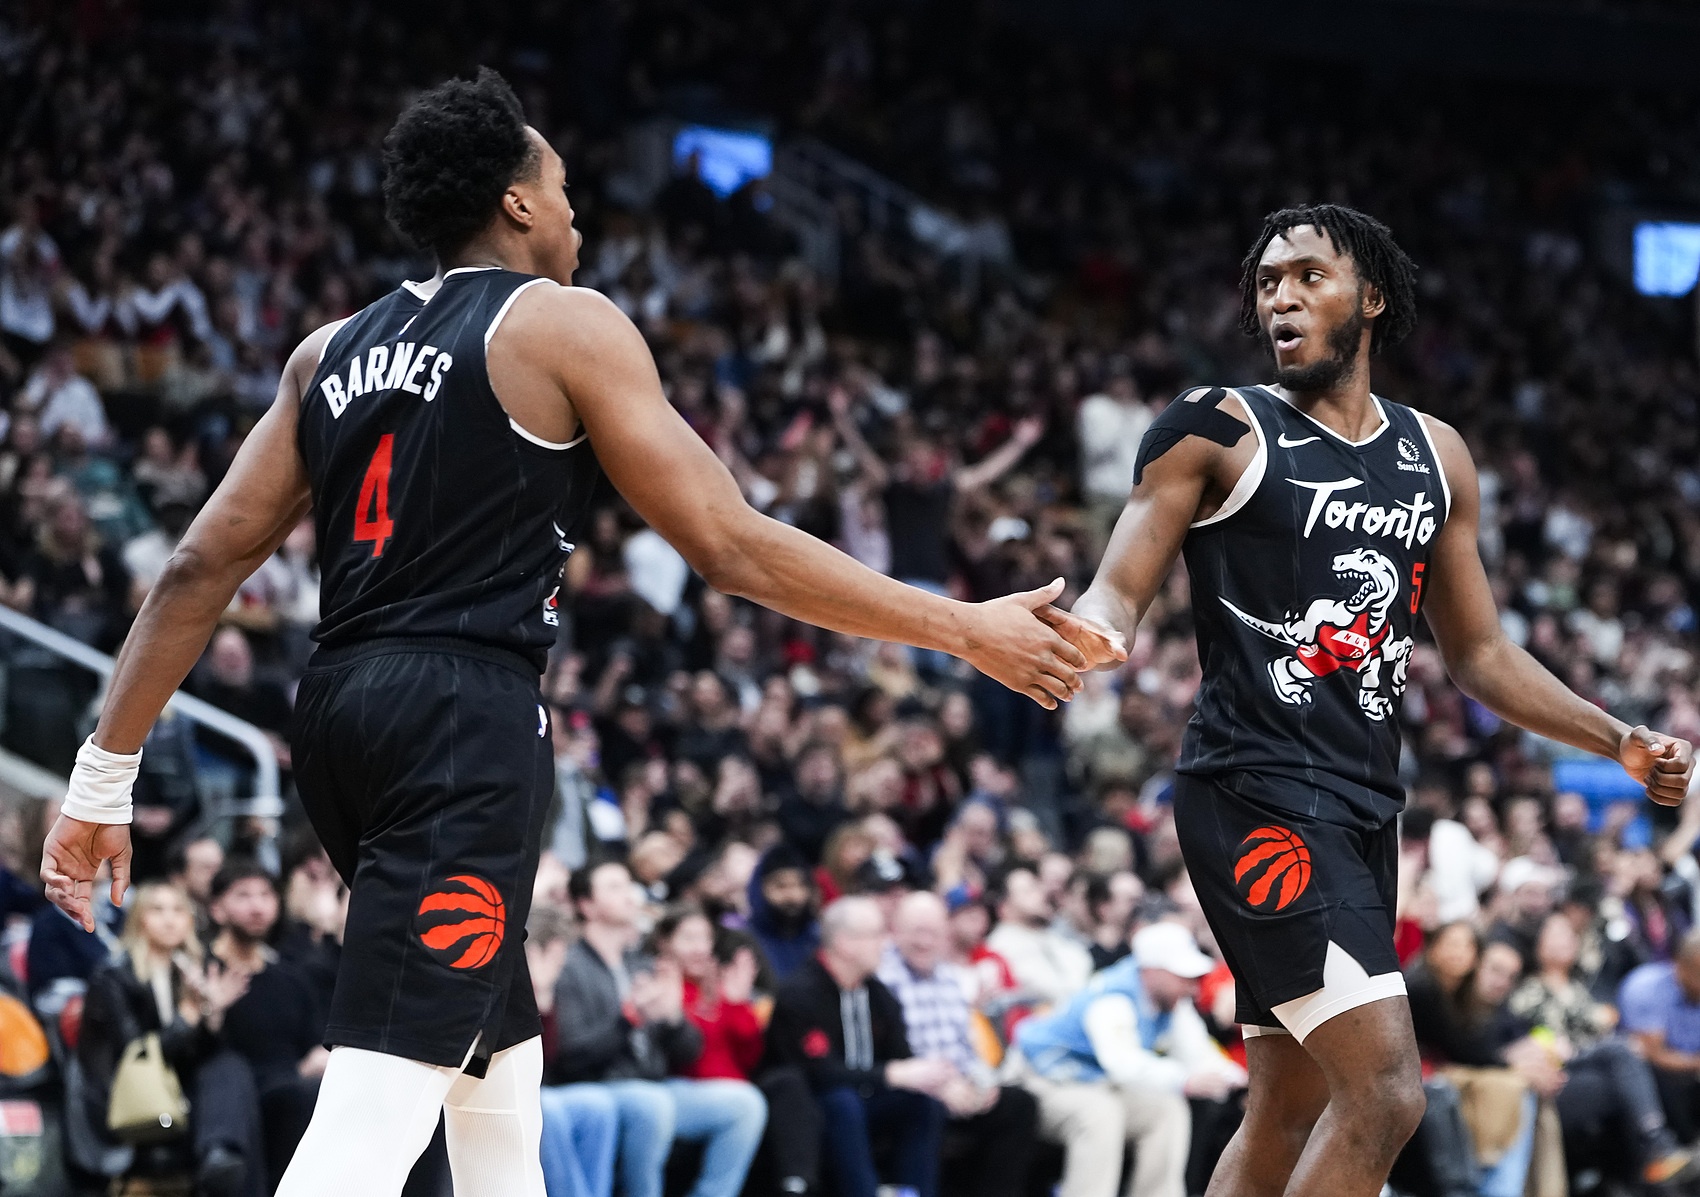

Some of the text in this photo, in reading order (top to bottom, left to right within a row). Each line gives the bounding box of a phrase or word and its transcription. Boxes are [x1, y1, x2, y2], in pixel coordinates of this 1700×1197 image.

[319, 342, 452, 419] BARNES
[353, 433, 394, 557] 4
[1396, 460, 1430, 474] Sun Life
[1284, 476, 1437, 550] Toronto
[1410, 562, 1426, 614] 5
